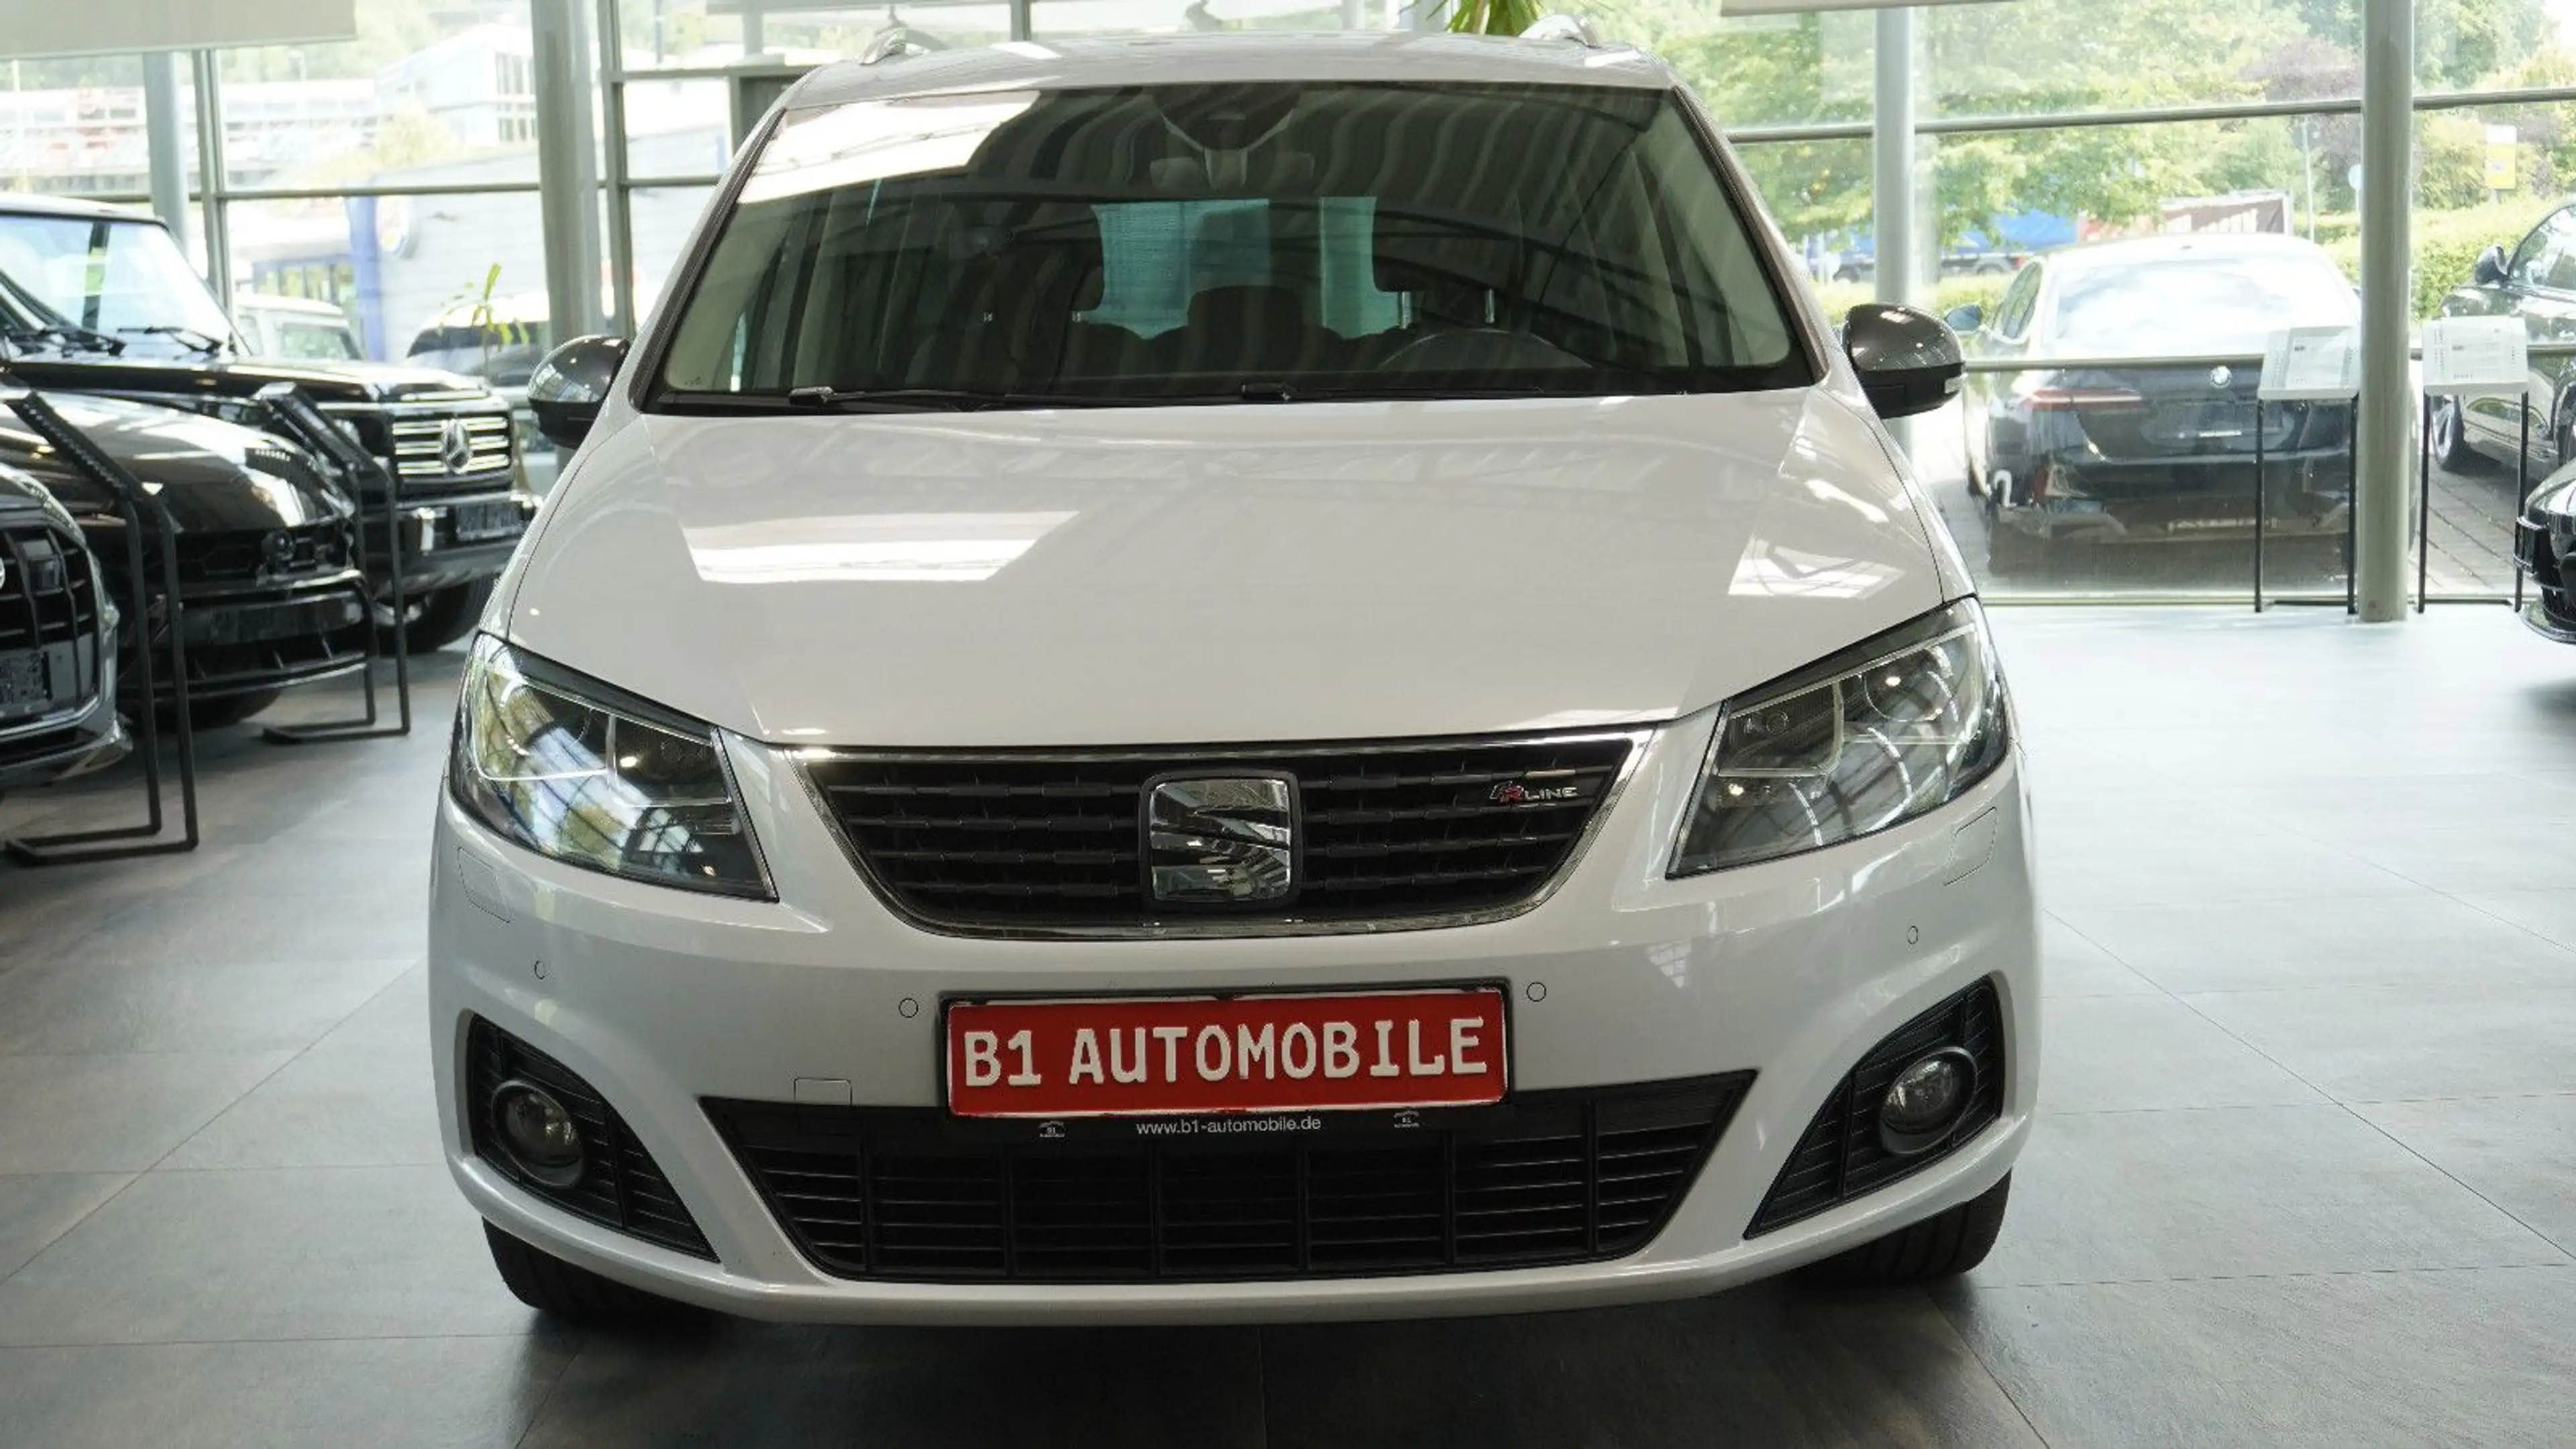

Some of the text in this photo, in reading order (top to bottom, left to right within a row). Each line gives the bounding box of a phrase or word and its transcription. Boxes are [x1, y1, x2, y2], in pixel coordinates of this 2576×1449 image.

[964, 1016, 1487, 1086] B1 AUTOMOBILE
[1136, 1116, 1322, 1134] www.b1-automobile.de
